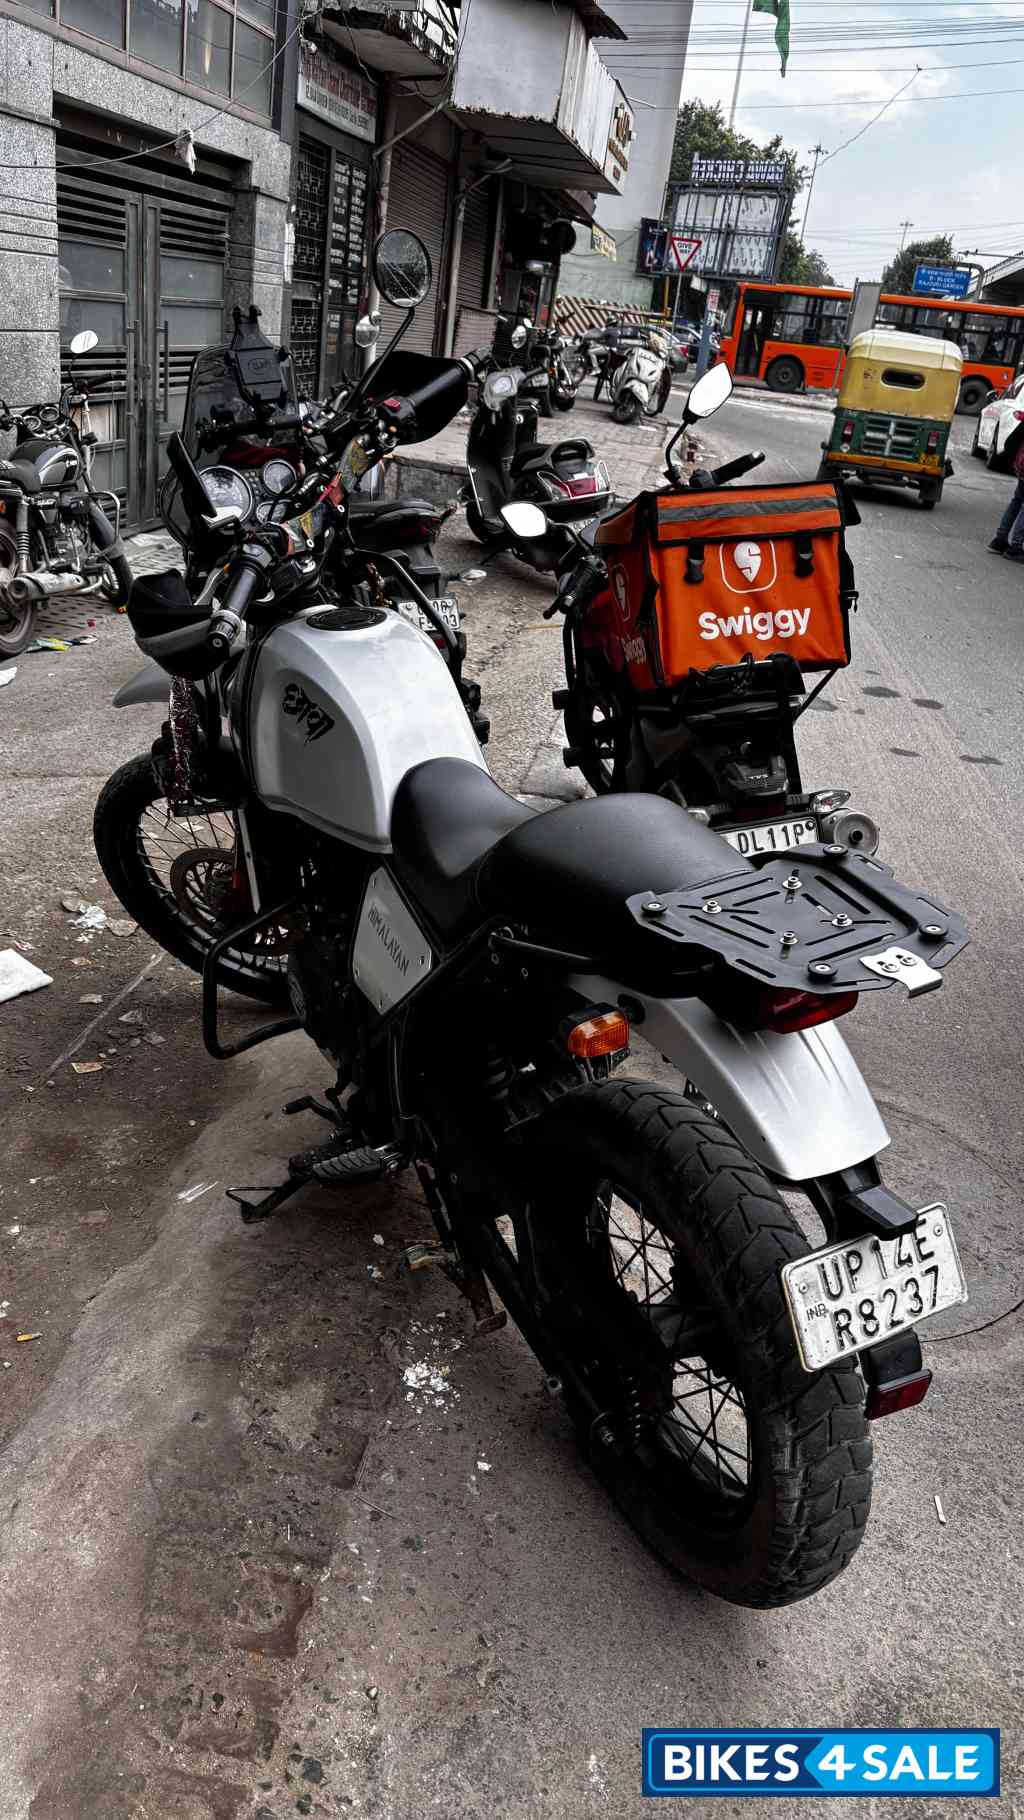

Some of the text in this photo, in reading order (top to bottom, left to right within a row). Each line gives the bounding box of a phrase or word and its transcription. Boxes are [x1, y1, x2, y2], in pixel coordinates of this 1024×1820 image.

[677, 242, 693, 250] GIVE
[698, 606, 811, 640] Swiggy
[368, 907, 410, 976] HIMALAYAN
[831, 1264, 939, 1351] R8237
